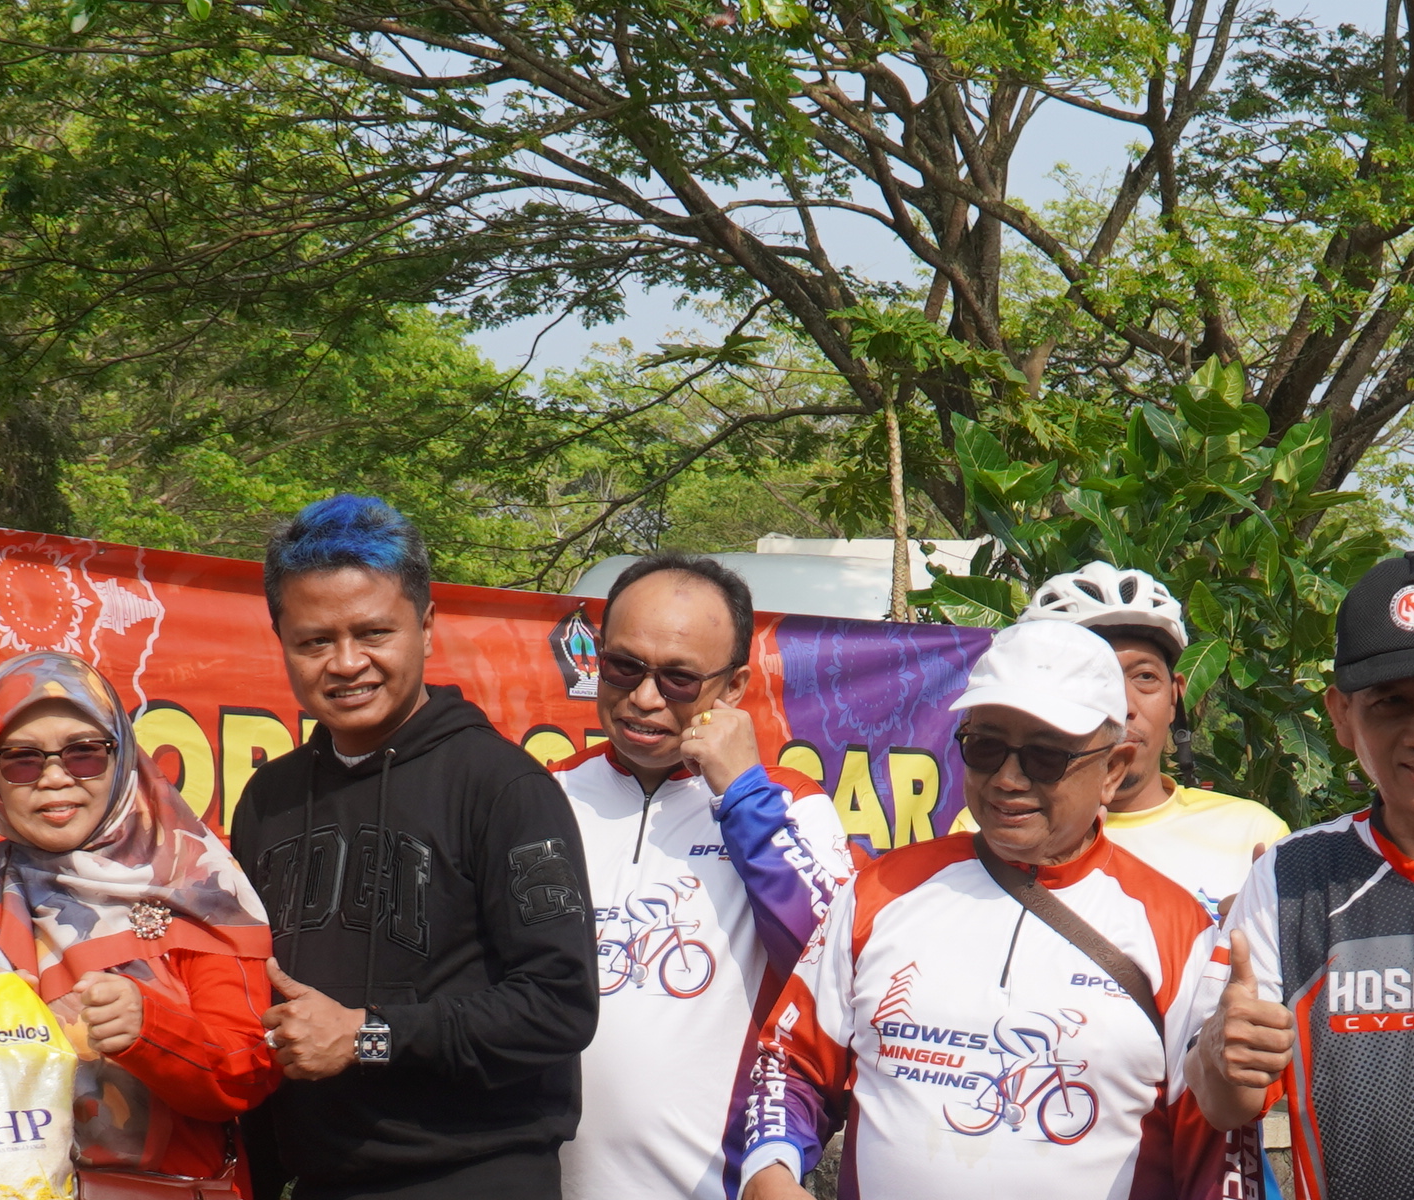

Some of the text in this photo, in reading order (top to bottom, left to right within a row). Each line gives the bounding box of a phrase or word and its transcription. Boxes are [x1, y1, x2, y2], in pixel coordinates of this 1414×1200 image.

[689, 844, 730, 856] BPC
[882, 1021, 989, 1050] GOWES
[880, 1044, 965, 1068] MINGGU
[894, 1065, 980, 1090] PAHING
